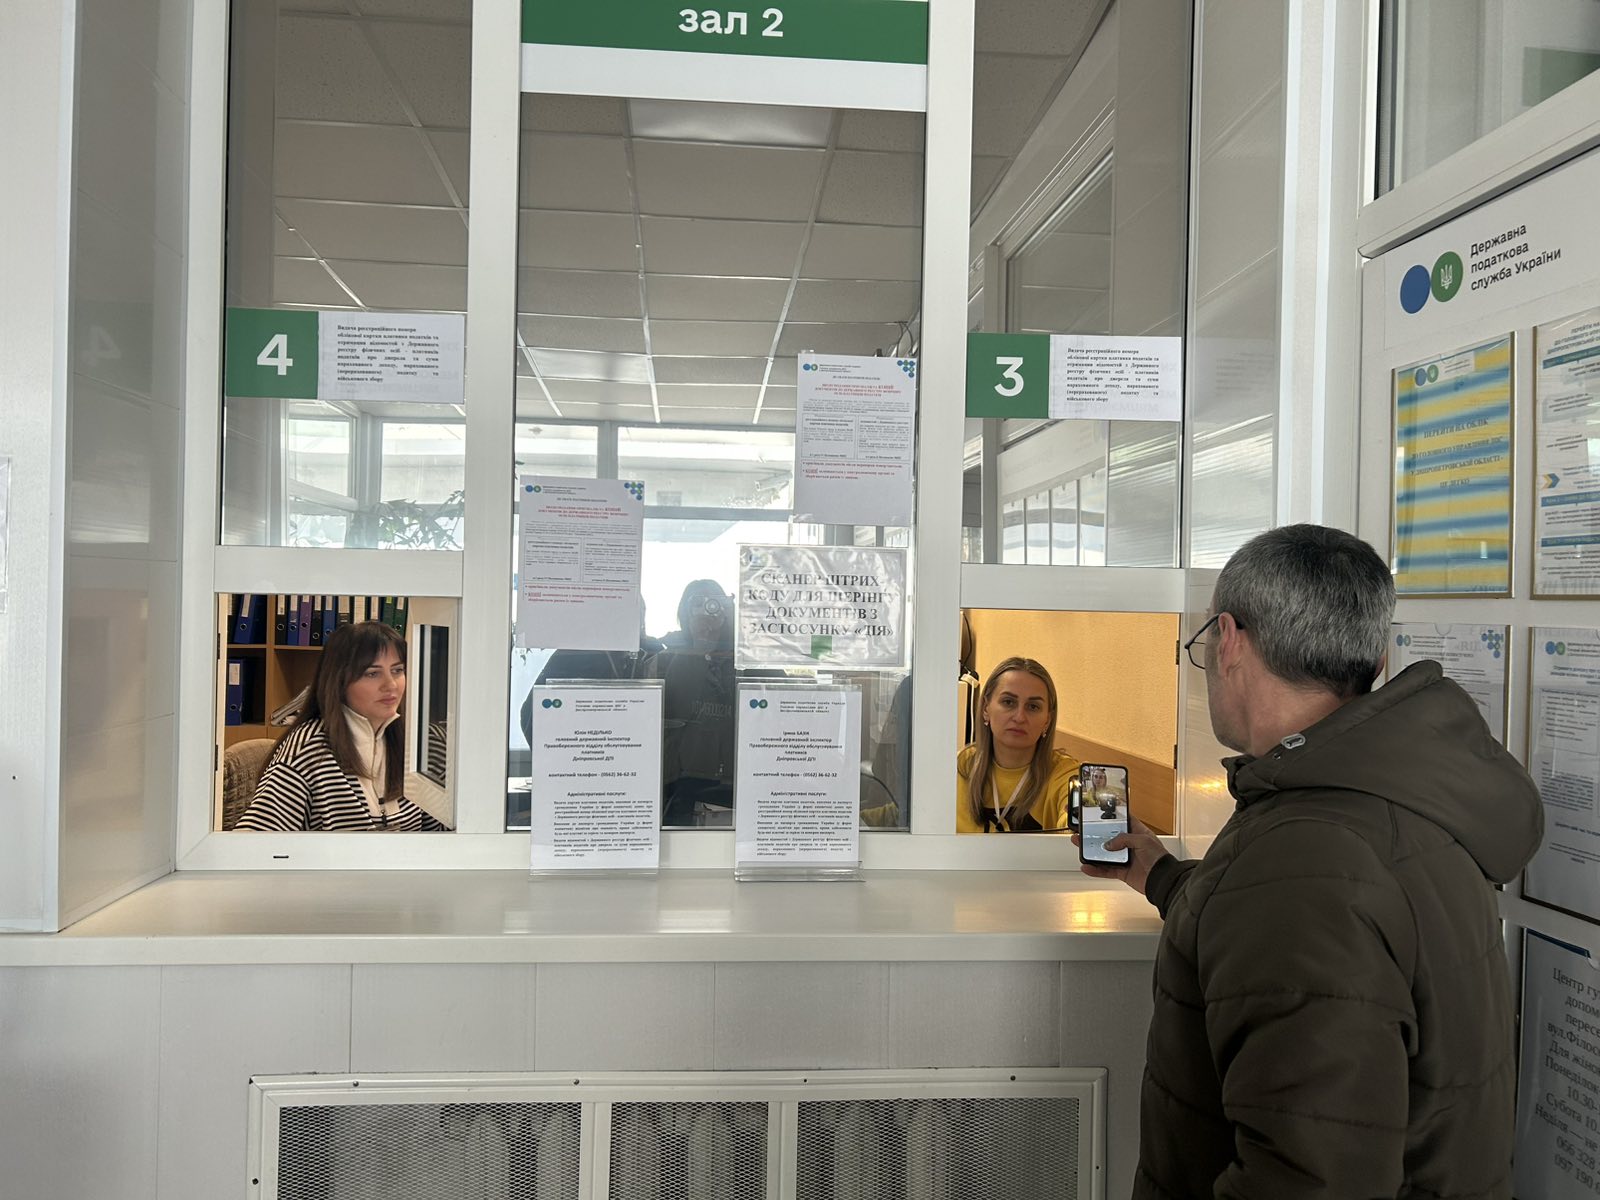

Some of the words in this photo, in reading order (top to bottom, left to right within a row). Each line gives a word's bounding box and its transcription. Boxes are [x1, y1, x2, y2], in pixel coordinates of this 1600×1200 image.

[678, 8, 748, 36] зал
[761, 7, 784, 37] 2
[1470, 224, 1527, 259] Державна
[1470, 242, 1529, 274] податкова
[1470, 266, 1512, 291] служба
[1514, 247, 1562, 274] України
[256, 333, 294, 376] 4
[993, 356, 1025, 397] 3
[761, 573, 822, 585] СКАНЕР
[748, 589, 790, 602] КОДУ
[793, 589, 823, 603] ДЛЯ
[749, 623, 851, 635] ЗАСТОСУНКУ
[1552, 967, 1585, 994] Центр
[1548, 1040, 1570, 1061] Для
[1535, 1103, 1569, 1133] Неділя
[1546, 1092, 1581, 1123] Субота
[1556, 1135, 1575, 1156] 066
[1575, 1148, 1595, 1171] 328
[1554, 1153, 1574, 1173] 097
[1575, 1167, 1594, 1190] 190
